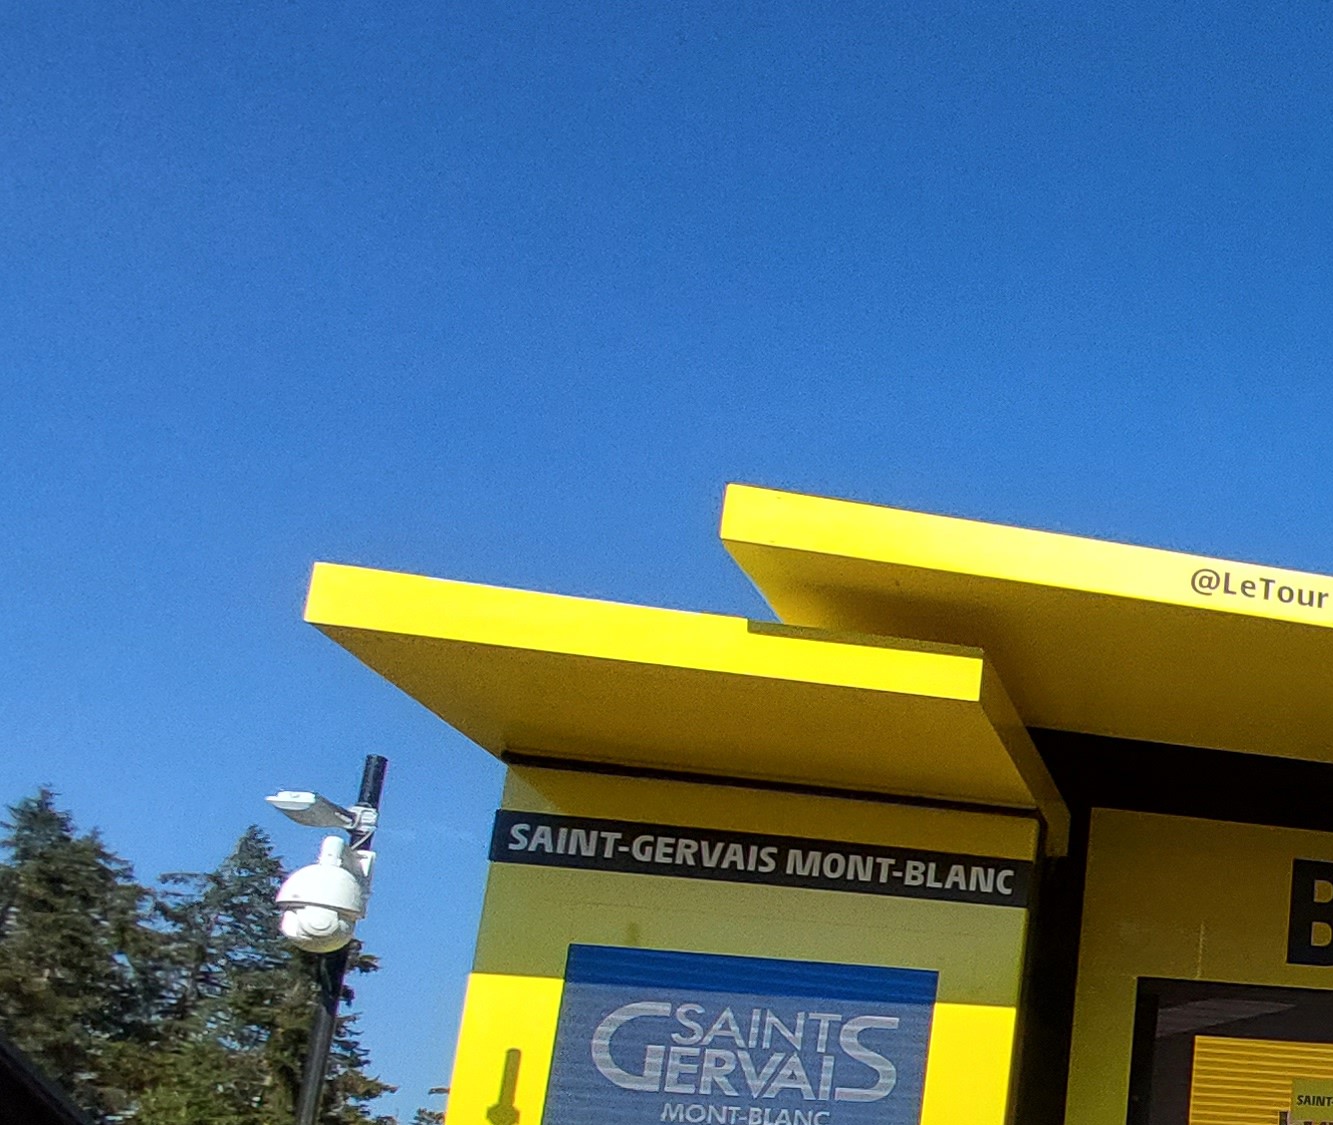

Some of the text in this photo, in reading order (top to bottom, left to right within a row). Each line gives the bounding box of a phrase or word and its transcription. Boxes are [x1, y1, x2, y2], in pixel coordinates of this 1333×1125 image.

[1190, 567, 1330, 610] @LeTour
[508, 822, 1015, 896] SAINT-GERVAIS MONT-BLANC
[591, 1001, 900, 1103] GERVAIS
[671, 1003, 841, 1053] SAINT
